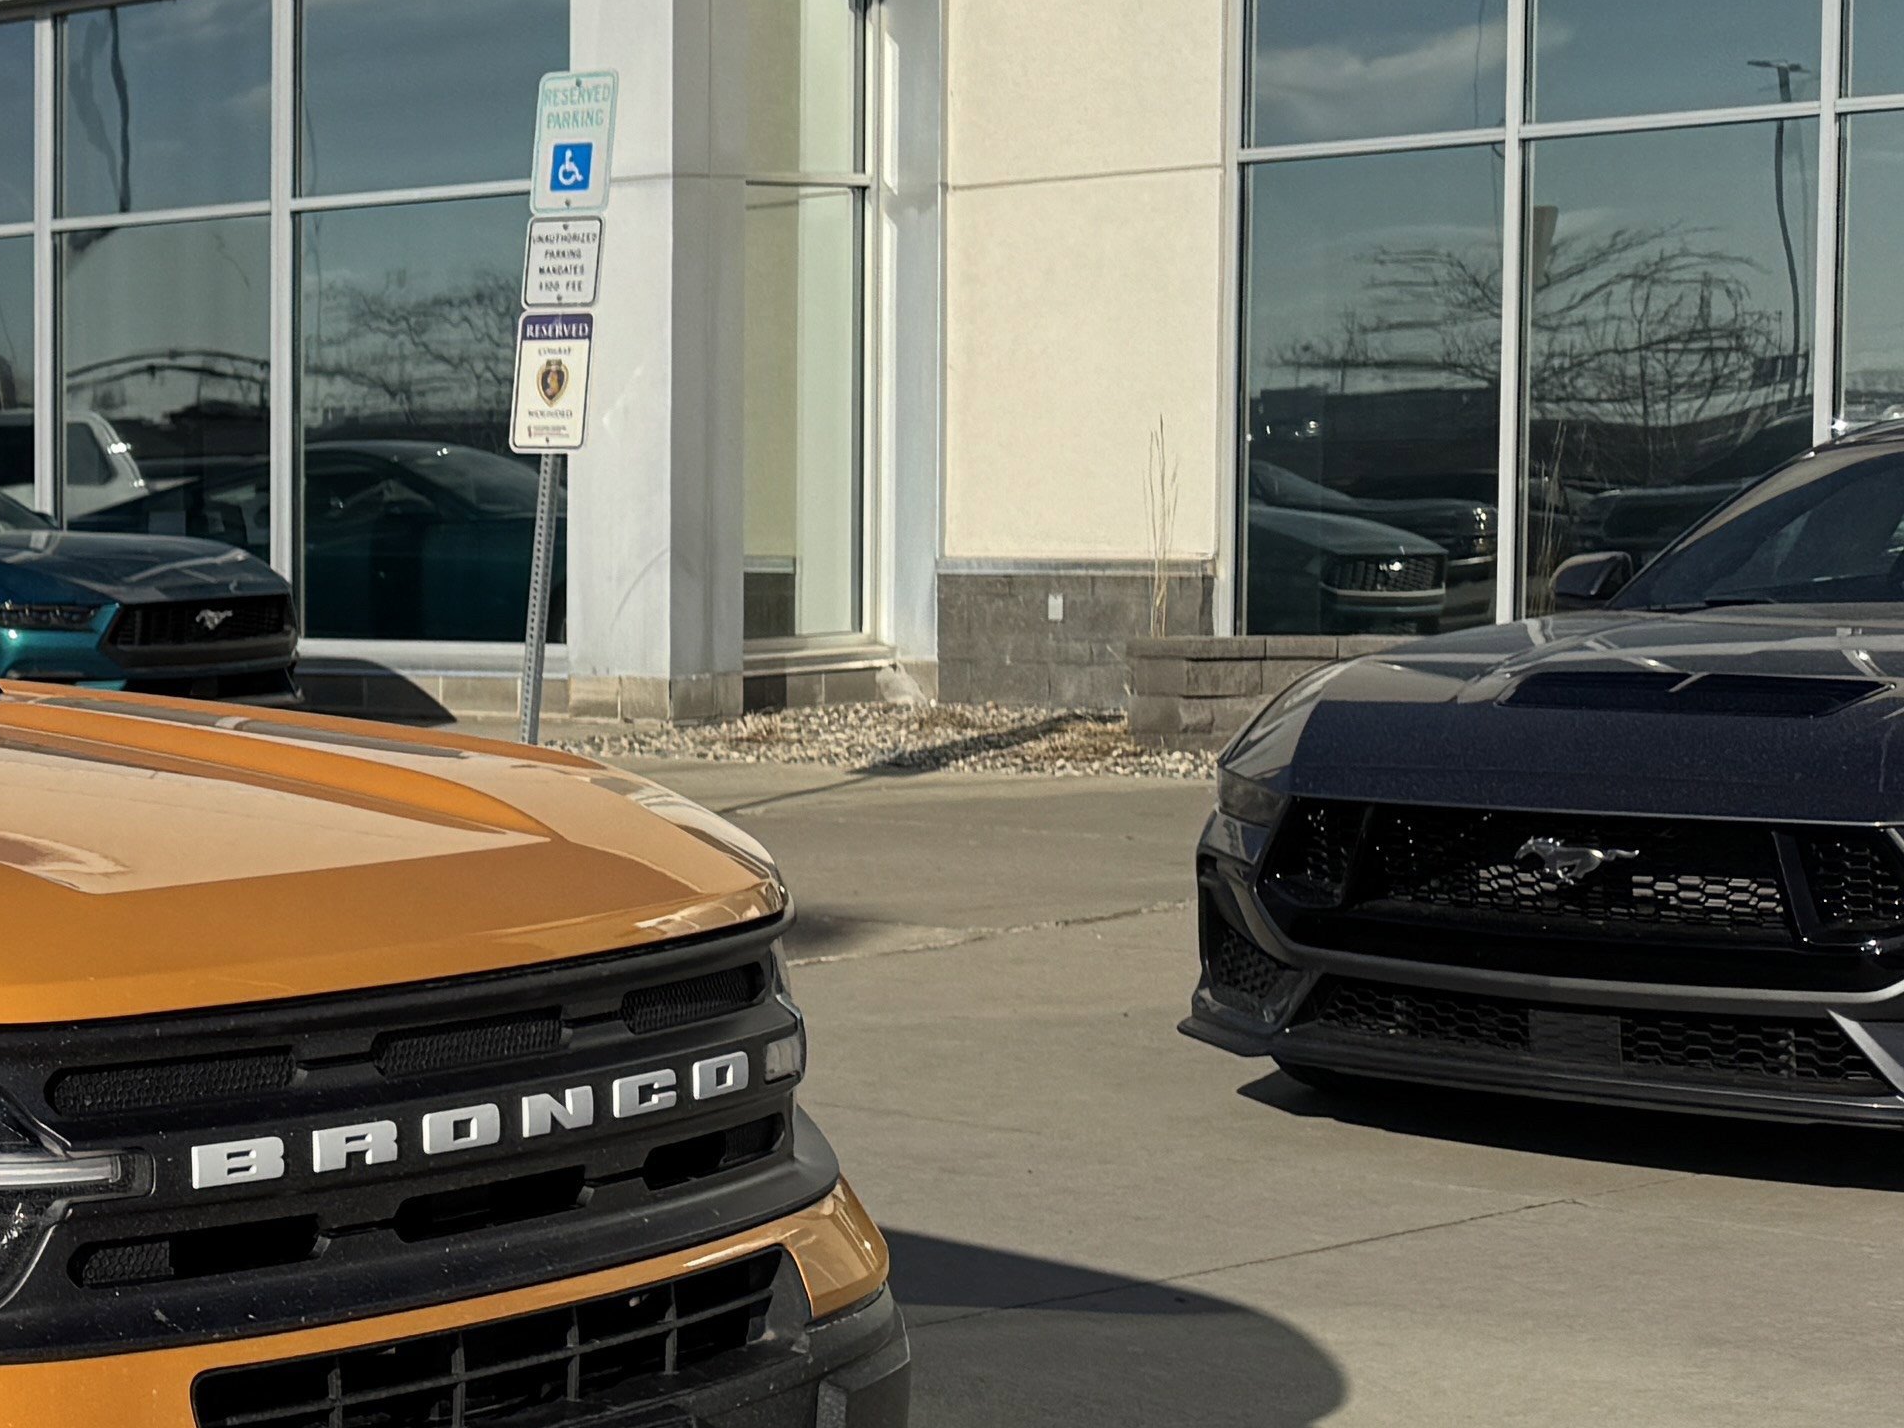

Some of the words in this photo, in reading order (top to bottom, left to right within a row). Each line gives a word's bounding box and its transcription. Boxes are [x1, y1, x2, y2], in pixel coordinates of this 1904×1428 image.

[543, 84, 610, 106] RESERVED
[547, 109, 604, 129] PARKING
[532, 233, 597, 244] UNAUTHORIZED
[544, 248, 582, 260] PARKING
[526, 322, 589, 339] RESERVED
[191, 1051, 749, 1190] BRONCO
